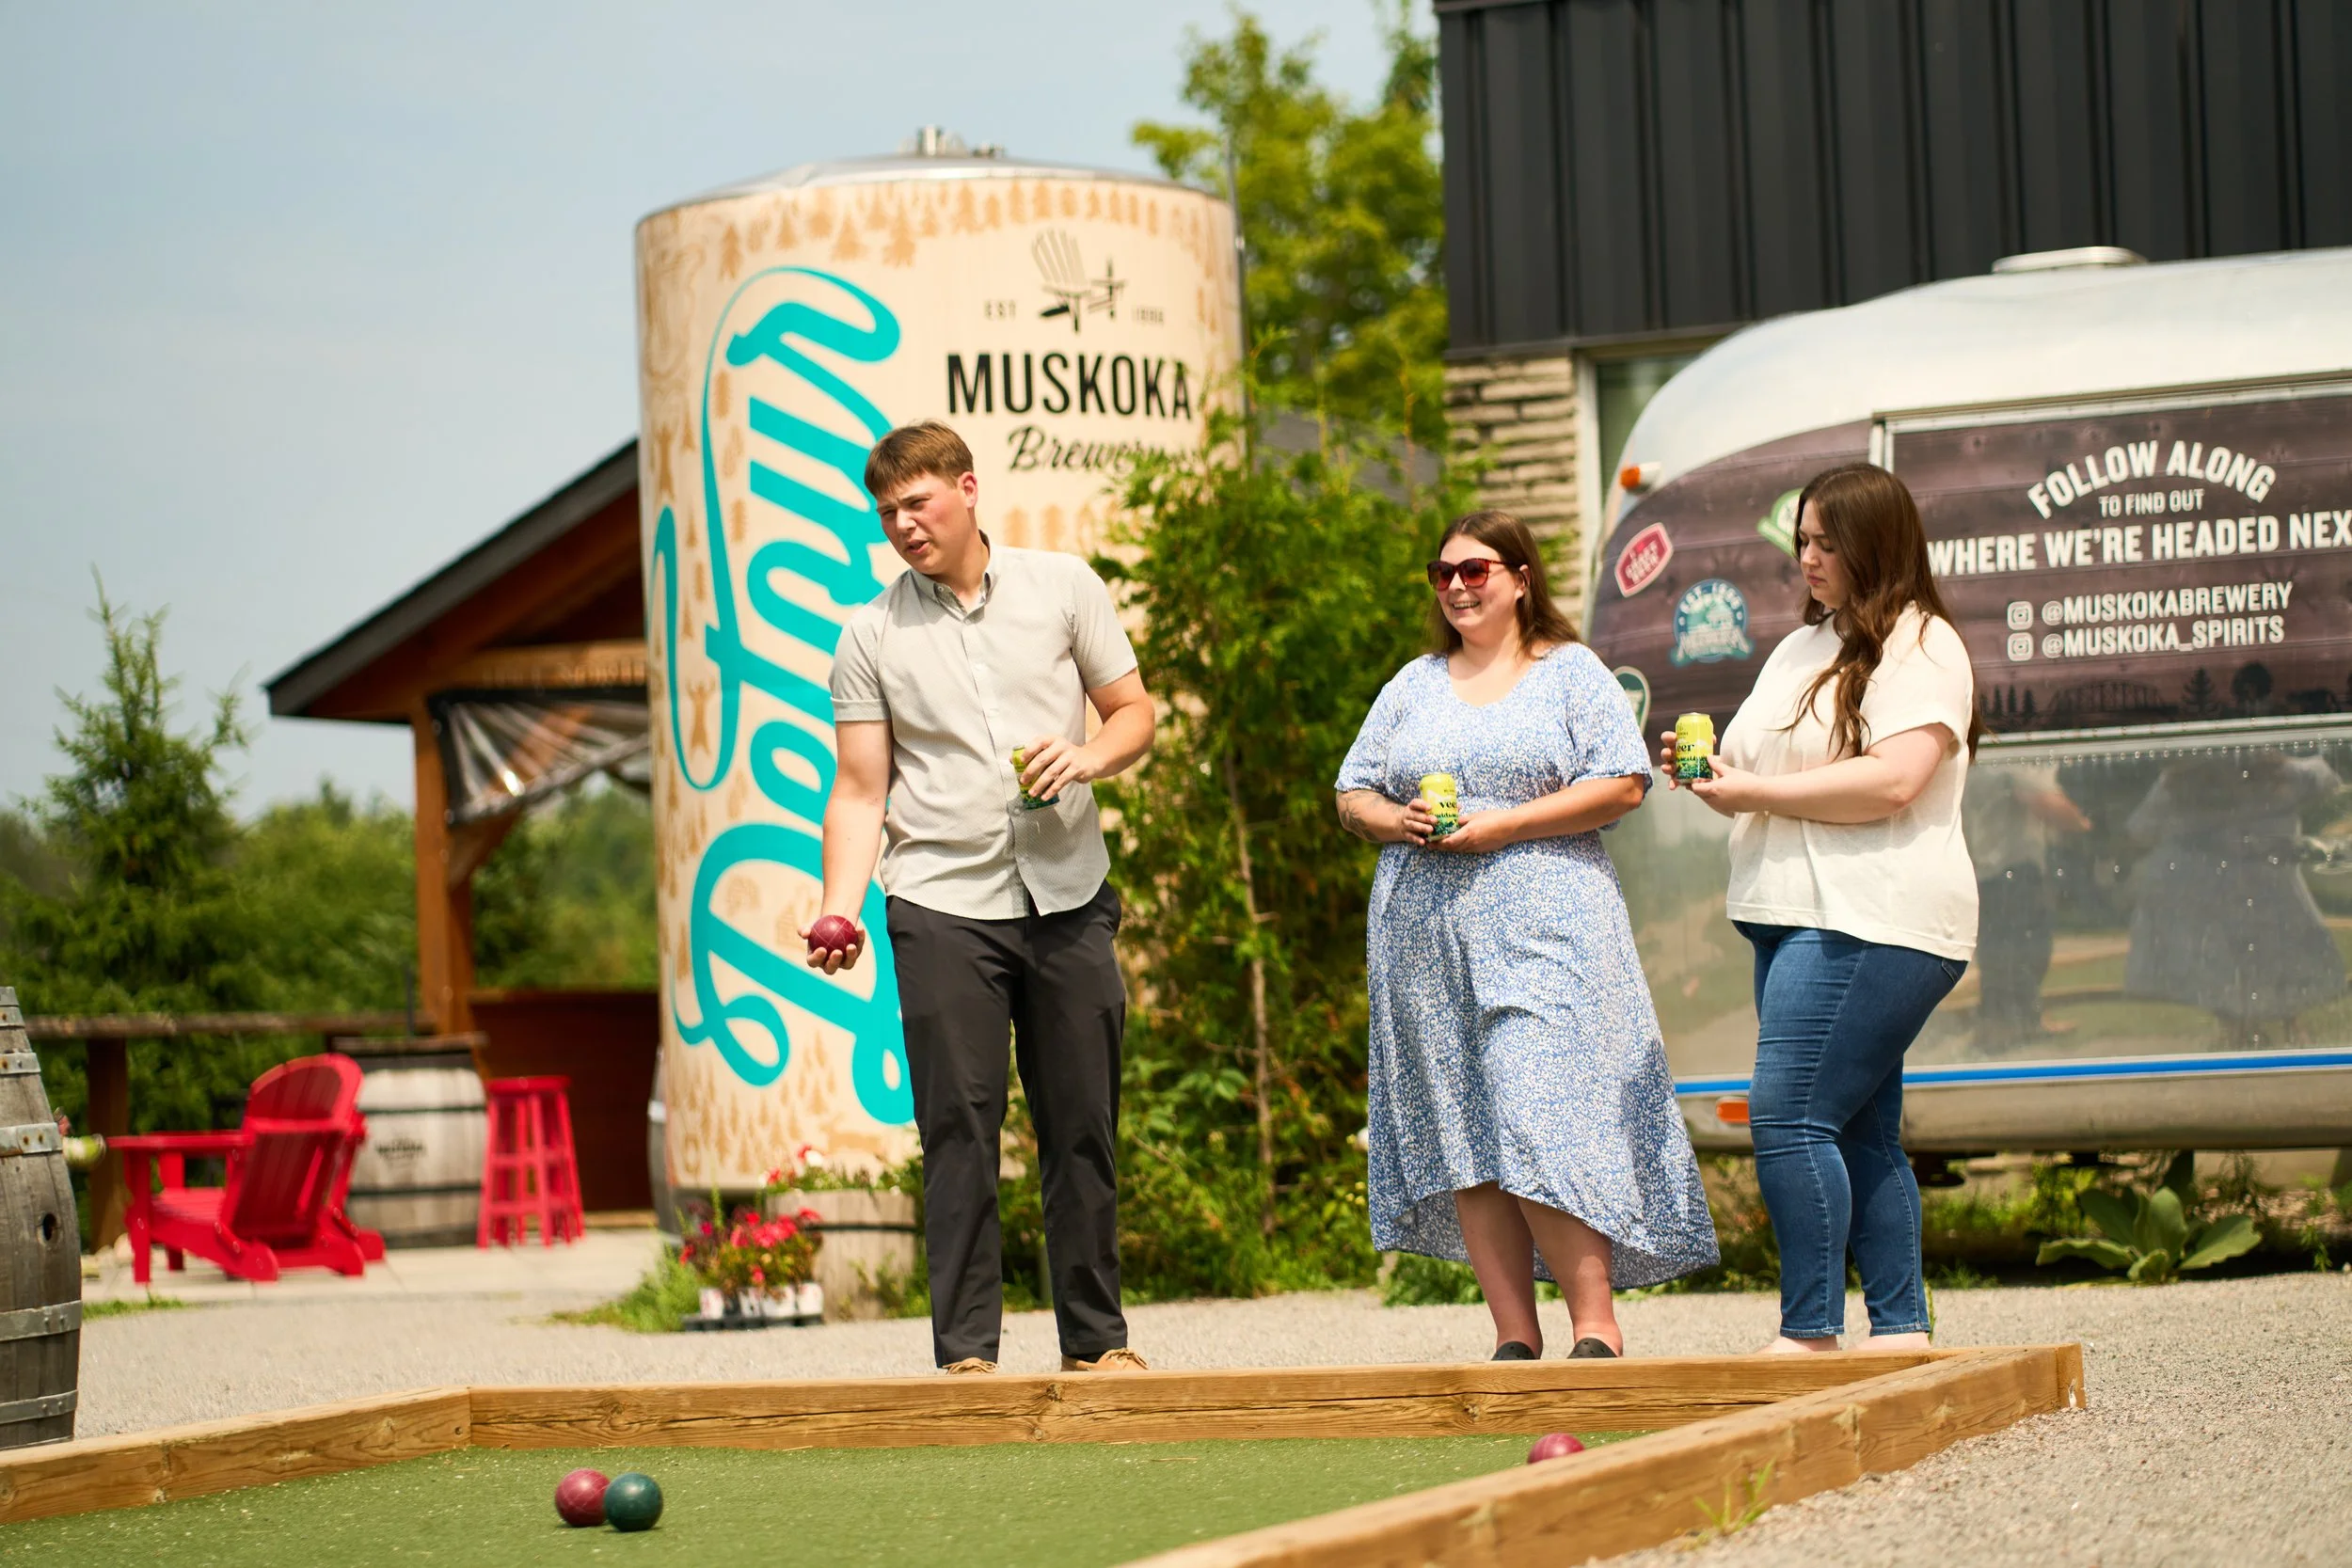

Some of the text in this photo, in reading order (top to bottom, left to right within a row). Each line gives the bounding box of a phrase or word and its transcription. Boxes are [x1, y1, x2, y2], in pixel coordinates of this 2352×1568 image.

[946, 352, 1192, 420] MUSKOKA
[2027, 440, 2276, 519] FOLLOW ALONG
[2099, 488, 2204, 517] TO FIND OUT
[1927, 510, 2352, 577] WHERE WE'RE HEADED NEX
[2042, 581, 2293, 626] @MUSKOKABREWERY
[2042, 615, 2284, 658] @MUSKOKA_SPIRITS
